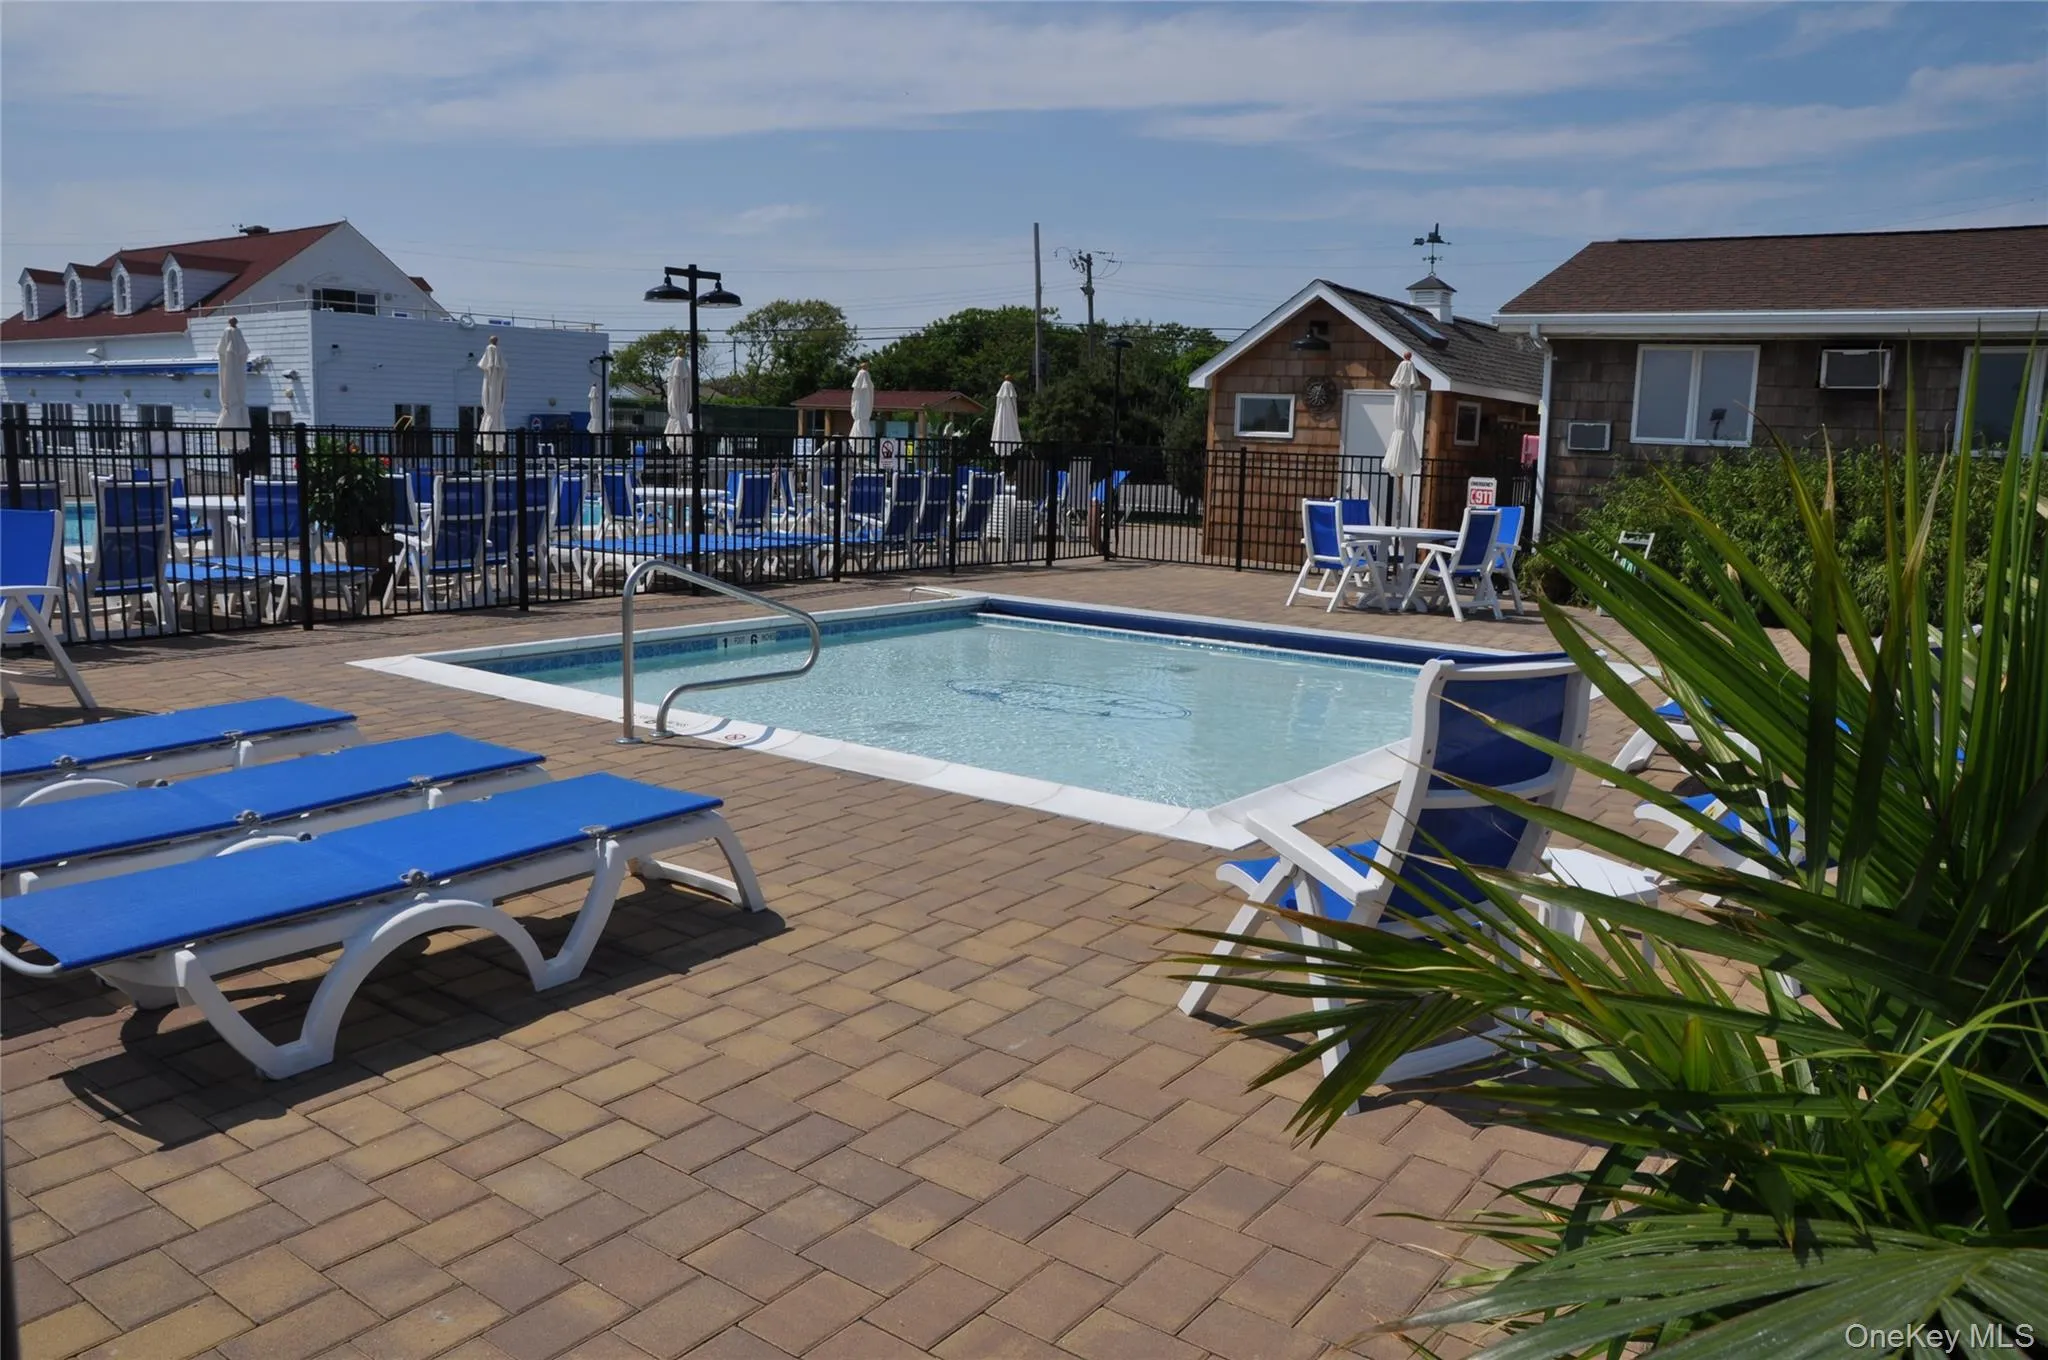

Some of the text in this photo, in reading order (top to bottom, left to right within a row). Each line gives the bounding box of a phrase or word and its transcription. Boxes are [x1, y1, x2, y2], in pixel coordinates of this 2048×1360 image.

[1475, 490, 1493, 504] 911
[723, 637, 728, 648] 1
[750, 634, 757, 645] 6
